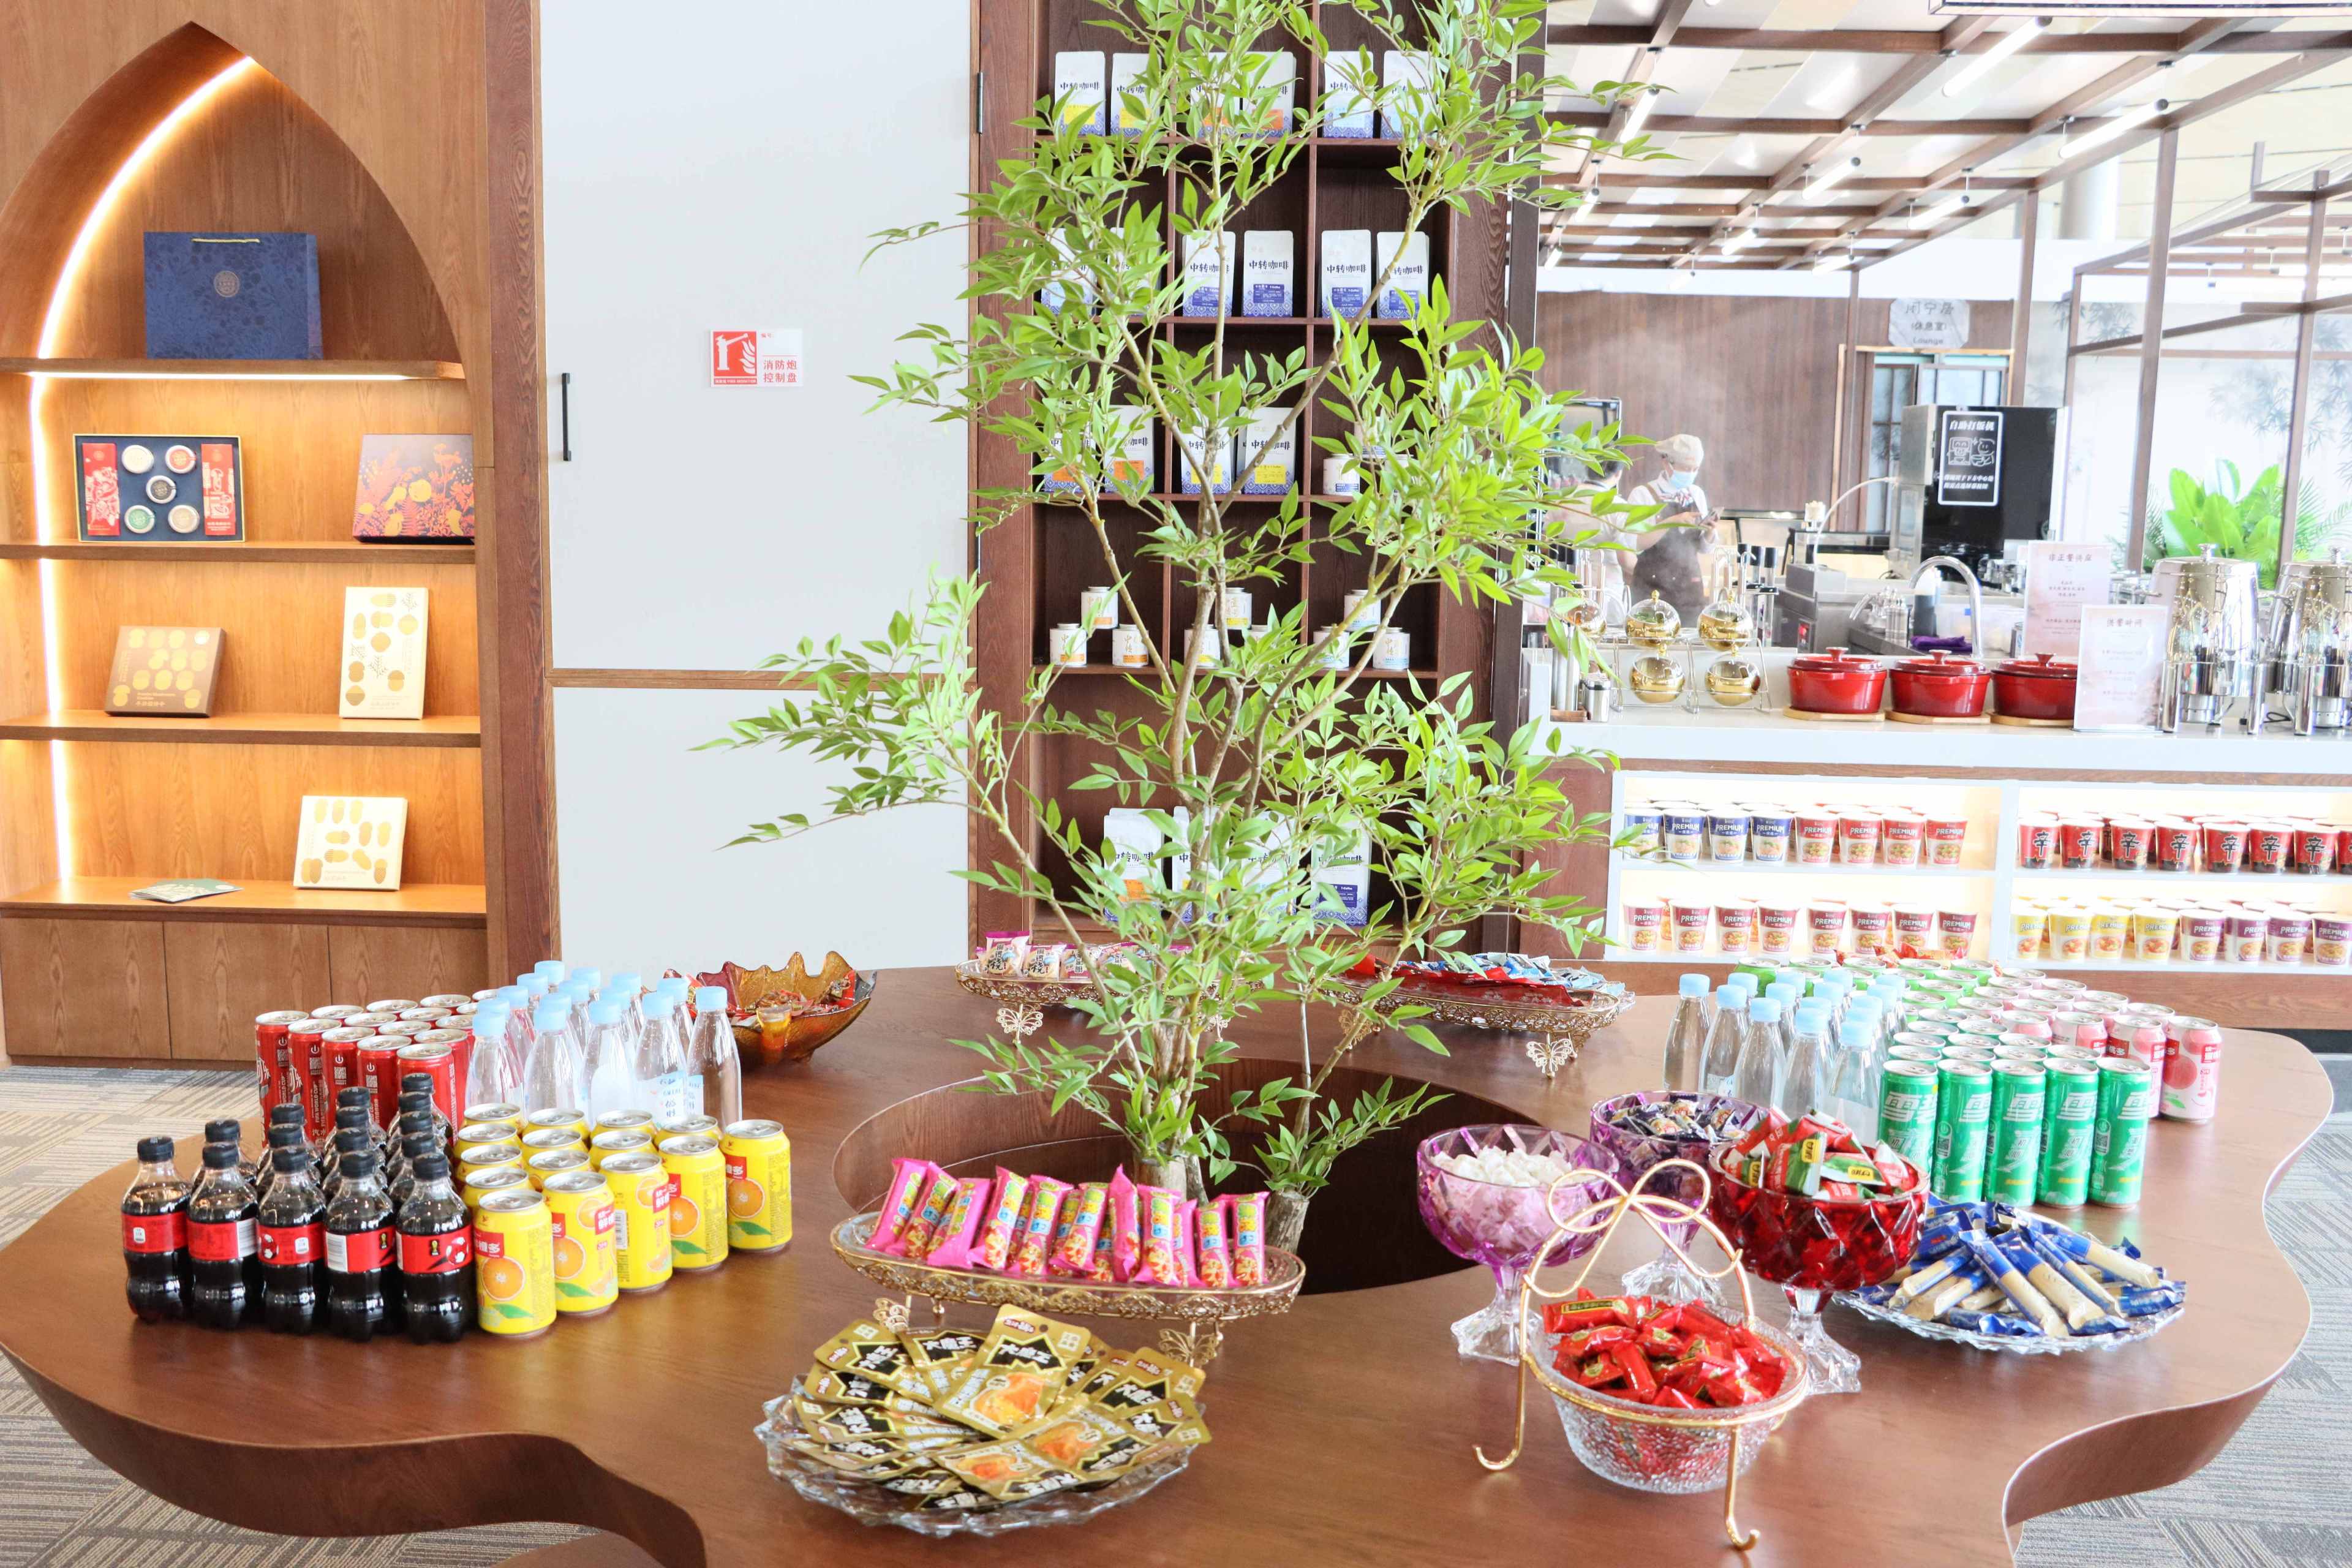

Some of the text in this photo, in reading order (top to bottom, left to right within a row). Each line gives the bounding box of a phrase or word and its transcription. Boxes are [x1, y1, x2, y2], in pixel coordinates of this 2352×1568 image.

[1249, 260, 1289, 270] 中转咖啡
[1327, 264, 1366, 274] 中转咖啡
[764, 360, 797, 370] 消防炮
[764, 372, 797, 383] 控制盘
[1672, 823, 1700, 831] PREMIUM
[2034, 832, 2051, 856] 辛
[2078, 832, 2095, 856] 辛
[2121, 832, 2139, 856] 辛
[2171, 834, 2189, 858] 辛
[2221, 835, 2239, 860] 辛
[2261, 835, 2280, 861] 辛
[2304, 837, 2325, 862] 辛
[1899, 919, 1928, 928] PREMIUM
[1942, 920, 1971, 929] PREMIUM
[2318, 927, 2350, 938] PREMIUM
[998, 1343, 1052, 1364] 大魔王
